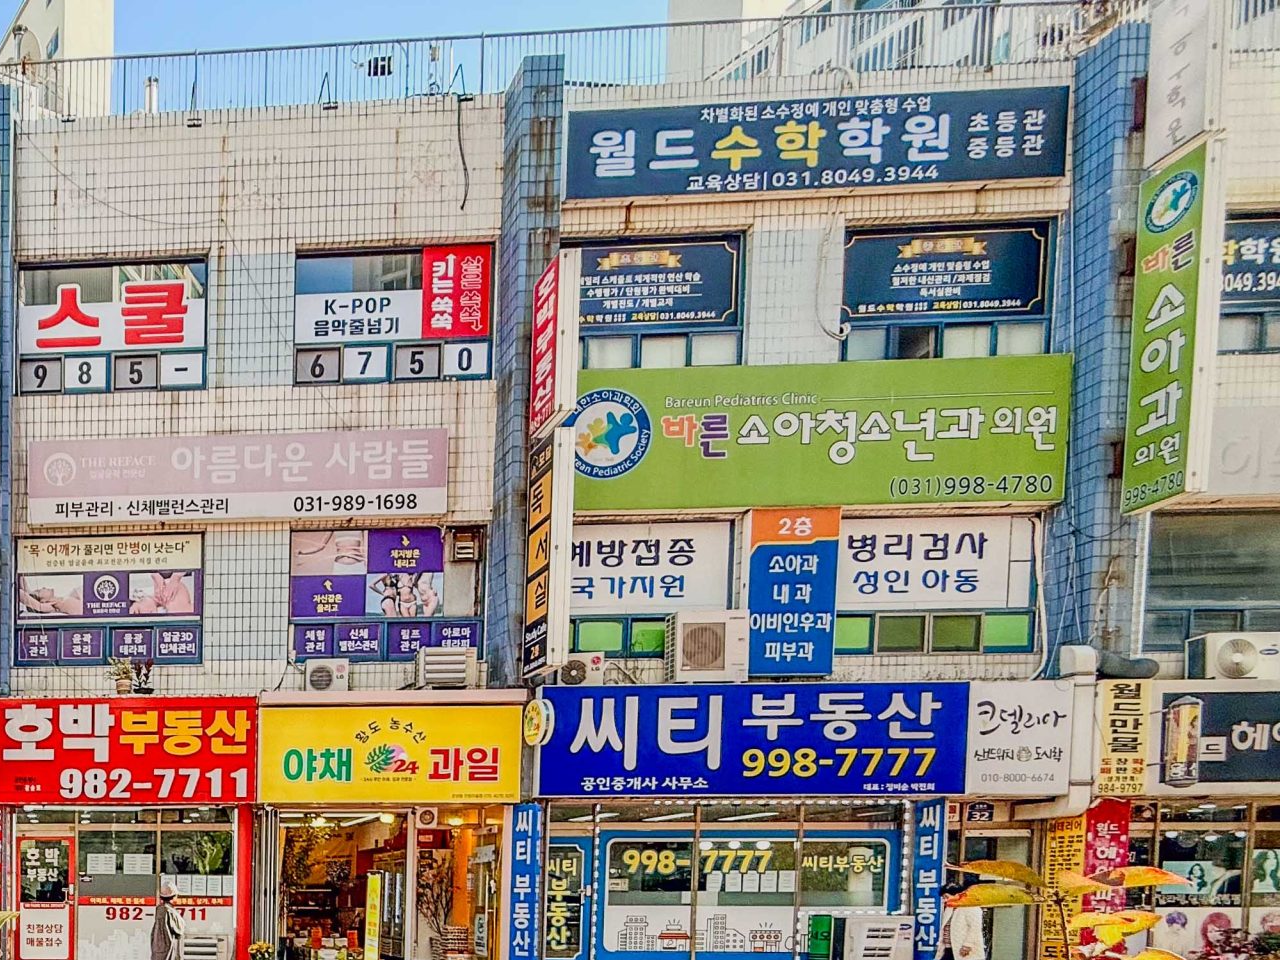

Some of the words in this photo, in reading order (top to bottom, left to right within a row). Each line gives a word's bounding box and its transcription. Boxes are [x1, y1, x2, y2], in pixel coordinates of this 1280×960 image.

[761, 100, 820, 121] 소수정예
[822, 98, 852, 117] 개인
[855, 97, 899, 115] 맞춤형
[903, 95, 931, 113] 수업
[968, 109, 1045, 133] 초등관
[968, 135, 1045, 159] 중등관
[1142, 230, 1196, 274] 바른
[36, 282, 188, 349] 스쿨
[324, 297, 391, 315] K-POP
[314, 317, 400, 337] 음악줄넘기
[1136, 282, 1187, 437] 소아과
[664, 395, 712, 409] Bareun
[714, 393, 779, 407] Pediatrics
[782, 391, 818, 406] Clinic
[661, 413, 729, 460] 바른
[736, 406, 986, 465] 소아청소년과
[989, 406, 1058, 452] 의원
[171, 442, 313, 484] 아름다운
[325, 438, 433, 481] 사람들
[1132, 431, 1181, 467] 의원
[889, 475, 1054, 498] (031)998-4780
[55, 501, 113, 518] 피부관리
[126, 497, 229, 516] 신체밸런스관리
[293, 493, 418, 513] 031-989-1698
[778, 517, 814, 537] 2층
[84, 543, 114, 556] 풀리면
[117, 541, 151, 555] 만병이
[847, 532, 989, 563] 병리검사
[769, 554, 819, 575] 소아과
[571, 574, 685, 600] 국가지원
[773, 583, 813, 604] 내과
[853, 569, 910, 595] 성인
[922, 569, 980, 593] 아동
[349, 628, 369, 640] 신체
[750, 612, 832, 635] 이비인후과
[305, 641, 326, 653] 관리
[764, 642, 815, 663] 피부과
[2, 703, 116, 763] 호박
[119, 709, 251, 756] 부동산
[569, 693, 724, 772] 씨티
[741, 691, 943, 742] 부동산
[283, 747, 353, 783] 야채
[392, 758, 420, 775] 24
[427, 746, 500, 783] 과일
[741, 747, 937, 778] 998-7777
[1033, 745, 1064, 761] 도시락
[59, 767, 249, 799] 982-7711
[580, 775, 659, 791] 공인중개사
[662, 775, 709, 790] 사무소
[980, 772, 1055, 783] 010-8000-6674
[1098, 783, 1144, 794] 984-9797
[971, 811, 990, 821] 32
[514, 809, 534, 866] 씨티
[919, 804, 941, 860] 씨티
[26, 847, 60, 867] 호박
[547, 858, 577, 876] 씨티
[26, 867, 59, 883] 부동산
[511, 876, 532, 957] 부동산
[547, 877, 572, 956] 부동산
[916, 870, 940, 952] 부동산
[26, 923, 64, 933] 친절상담
[26, 937, 63, 948] 매물접수
